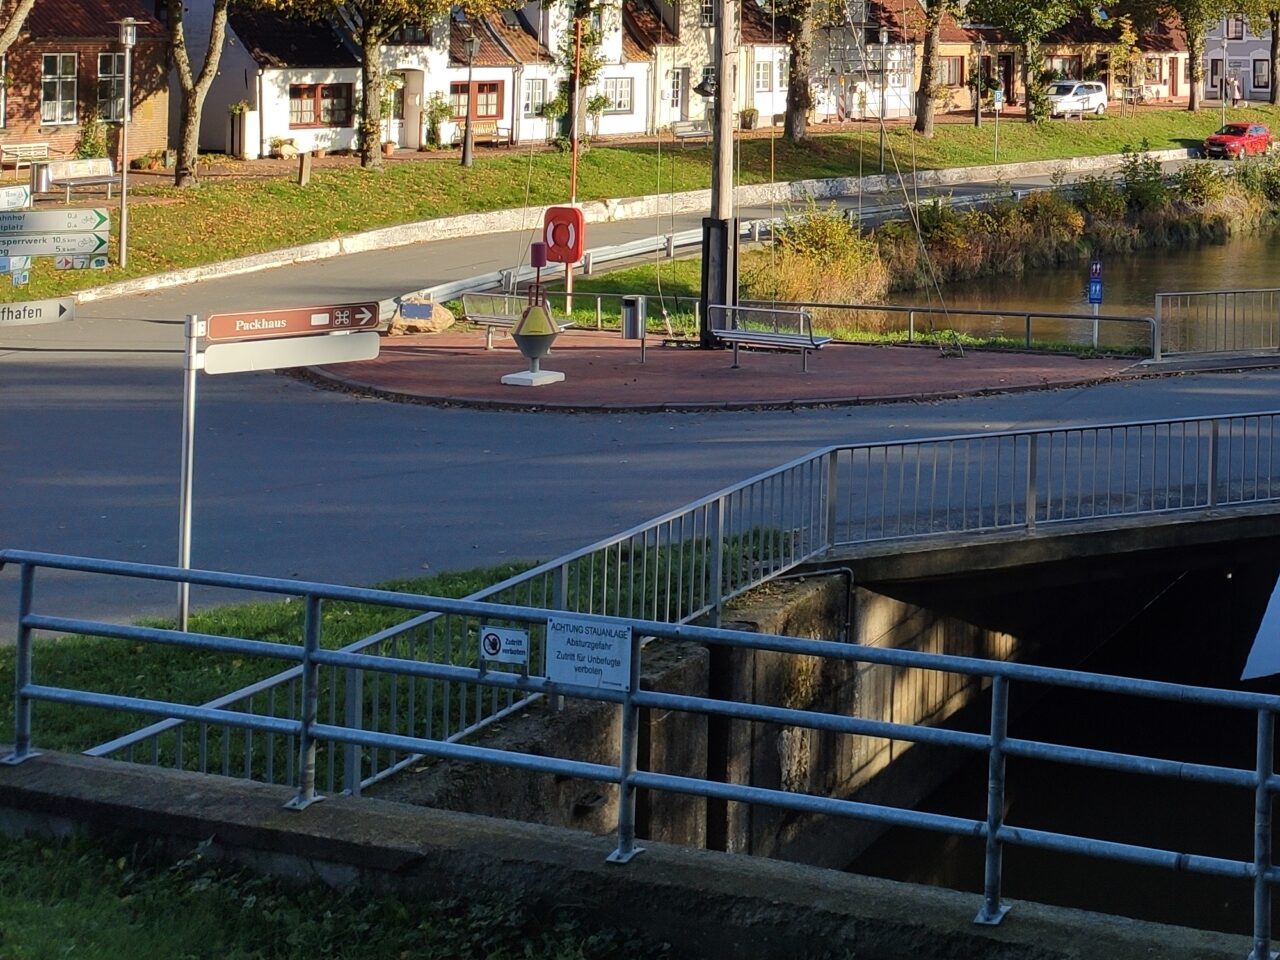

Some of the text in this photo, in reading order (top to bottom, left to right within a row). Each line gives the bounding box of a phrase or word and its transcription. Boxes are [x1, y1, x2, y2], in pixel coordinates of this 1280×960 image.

[235, 319, 287, 331] Packhaus
[551, 622, 629, 639] ACHTUNG STAUANLAGE
[505, 638, 522, 646] Zutritt
[566, 637, 613, 651] Absturzgefahr
[502, 648, 526, 656] verboten
[556, 650, 622, 668] Zutritt für Unbefugte
[574, 665, 603, 676] verboten
